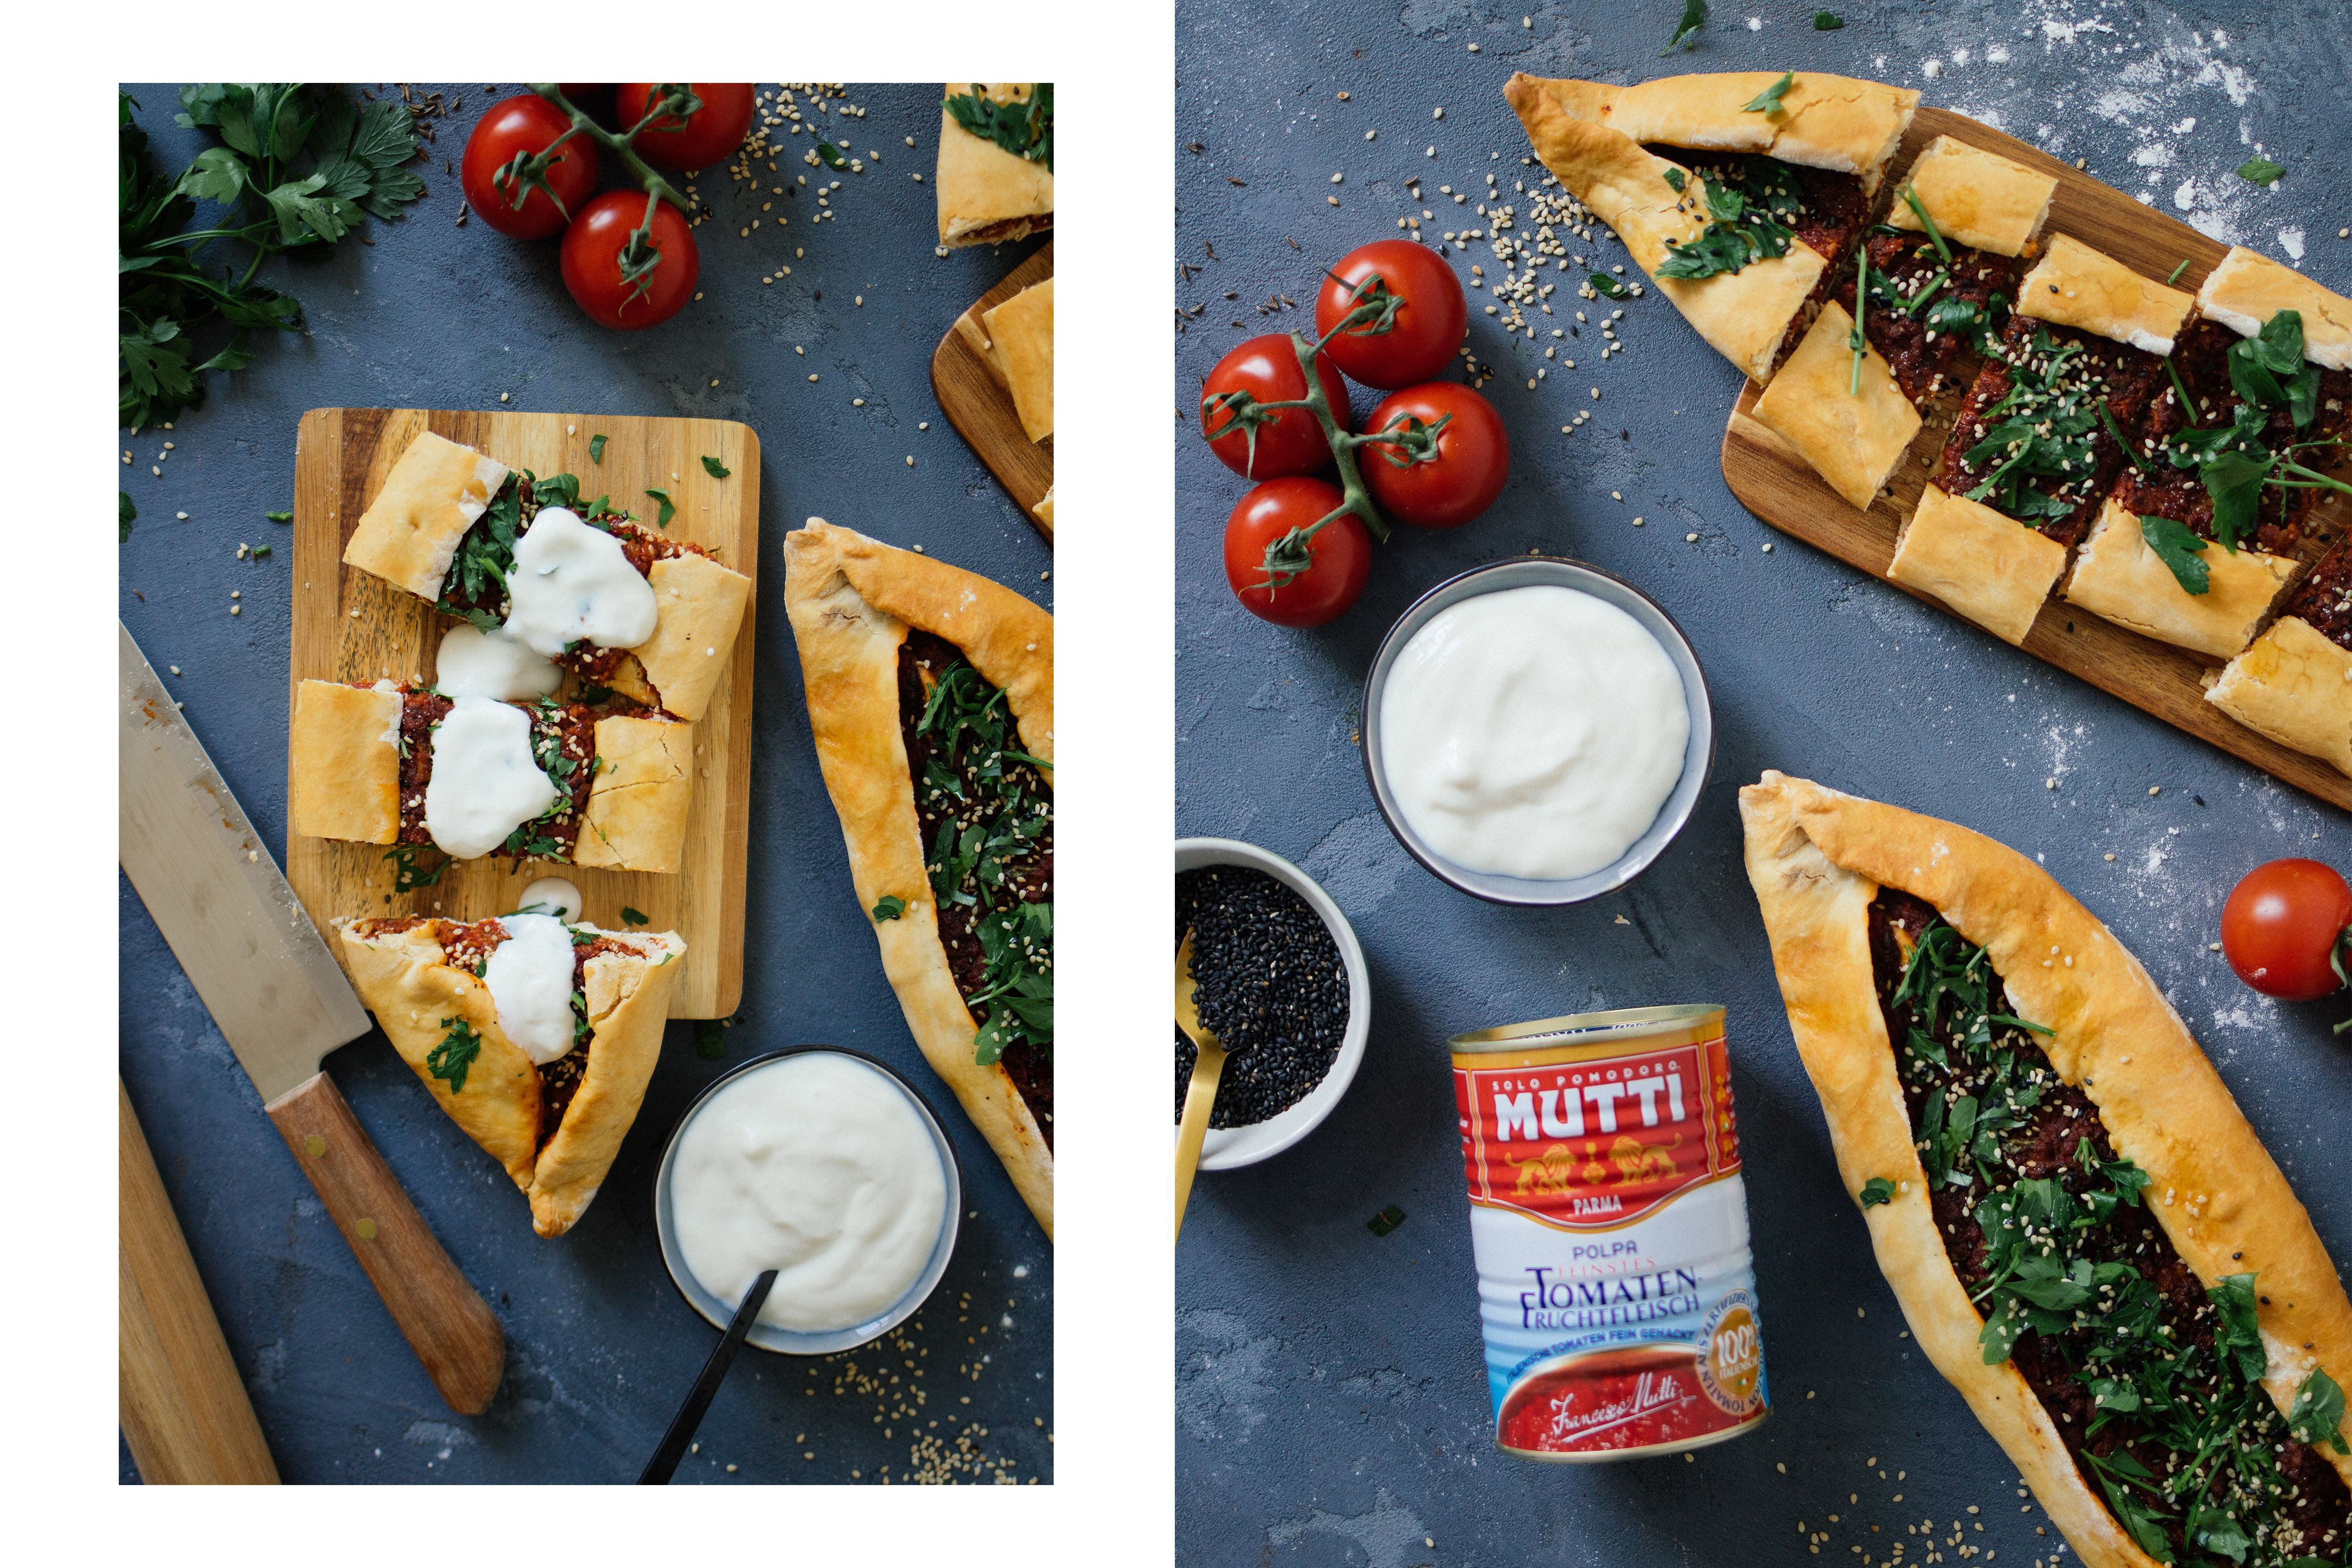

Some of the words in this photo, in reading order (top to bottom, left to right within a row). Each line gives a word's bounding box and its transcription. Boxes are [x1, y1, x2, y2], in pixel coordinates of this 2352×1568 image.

[1492, 1078, 1541, 1092] SOLO
[1556, 1060, 1678, 1086] POMODORO
[1494, 1073, 1686, 1141] MUTTI
[1572, 1194, 1623, 1216] PARMA
[1559, 1256, 1656, 1278] FEINSTES
[1572, 1239, 1638, 1260] POLPA
[1525, 1266, 1698, 1309] TOMATEN
[1519, 1292, 1699, 1330] FRUCHTFLEISCH
[1551, 1331, 1606, 1353] TOMATEN
[1609, 1328, 1637, 1341] FEIN
[1639, 1327, 1695, 1340] GEHACKT
[1716, 1324, 1758, 1368] 100%
[1626, 1372, 1681, 1413] Mutti
[1701, 1369, 1746, 1412] TOMATEN
